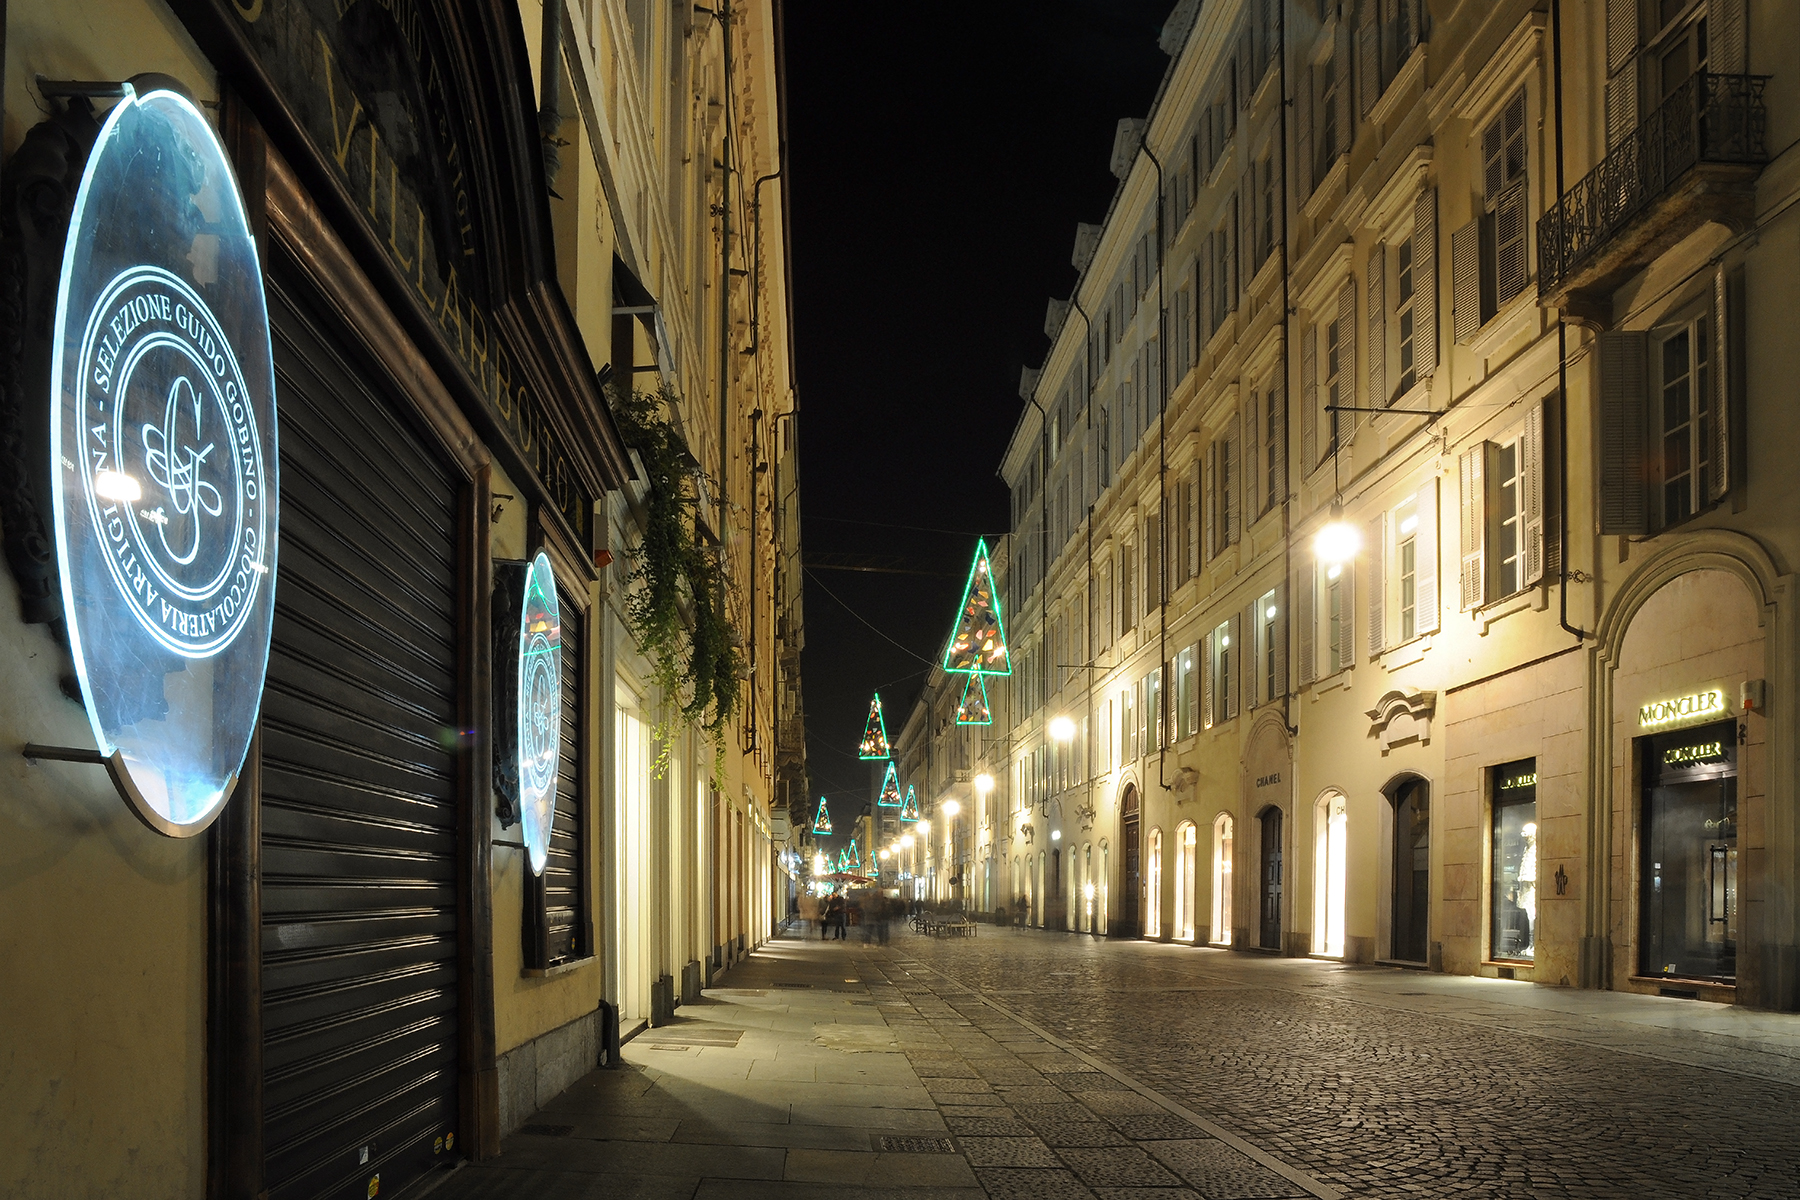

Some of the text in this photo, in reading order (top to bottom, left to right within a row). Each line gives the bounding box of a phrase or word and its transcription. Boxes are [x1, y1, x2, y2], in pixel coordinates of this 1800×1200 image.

[317, 30, 568, 514] VILLARBOITO
[95, 294, 172, 391] SELEZIONE
[174, 304, 226, 375] GUIDO
[226, 382, 257, 500] GOBINO
[91, 422, 160, 609] ARTIGINA
[160, 526, 258, 637] CIOCCOLATERIA
[1638, 690, 1720, 726] MONCLER
[1663, 741, 1721, 764] MONCLER
[1256, 772, 1281, 788] CHANEL
